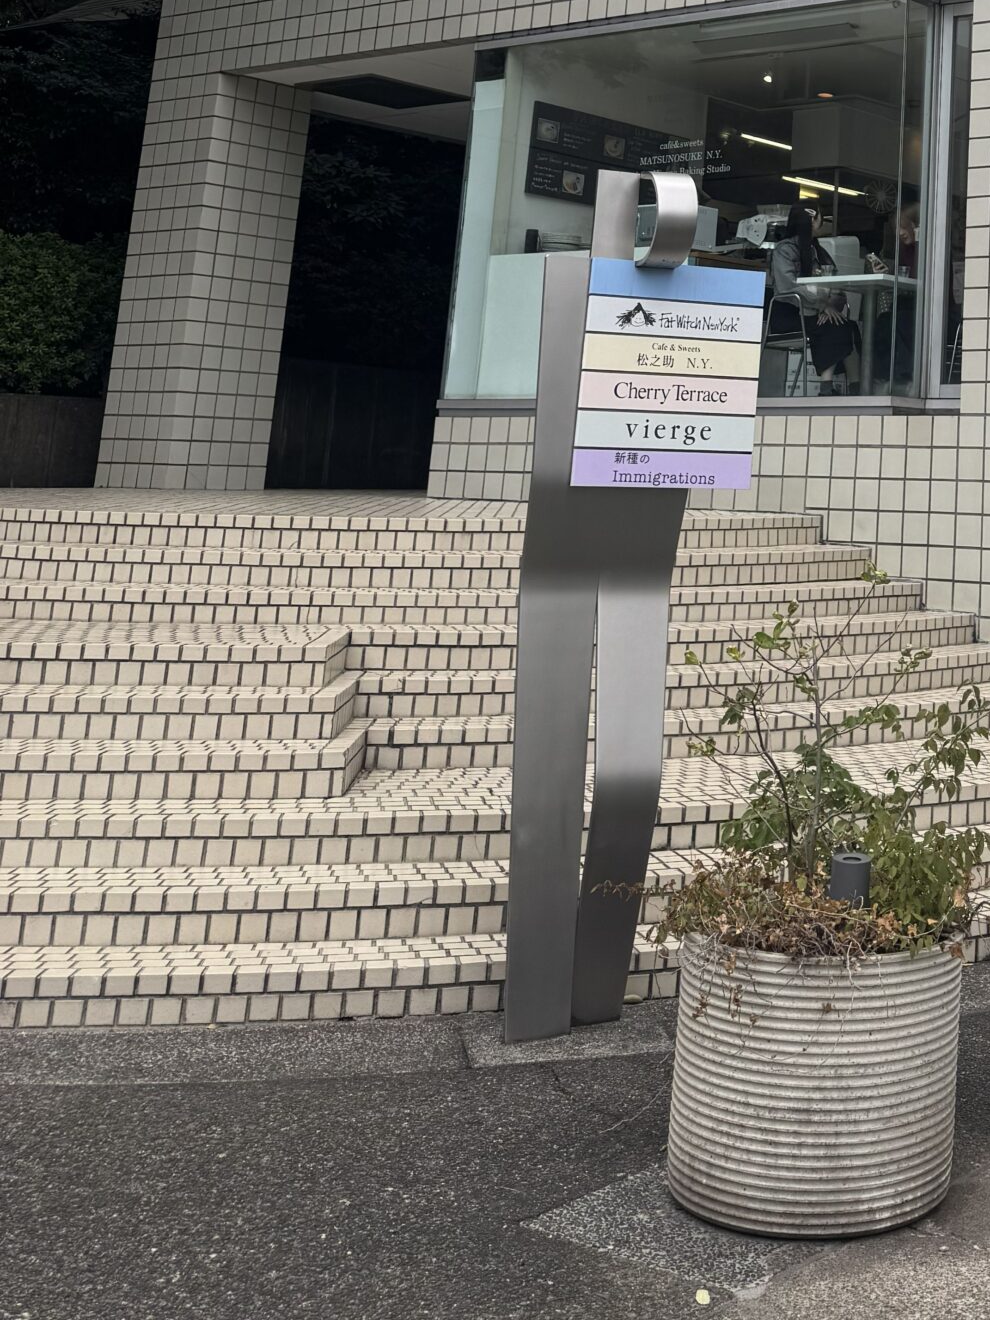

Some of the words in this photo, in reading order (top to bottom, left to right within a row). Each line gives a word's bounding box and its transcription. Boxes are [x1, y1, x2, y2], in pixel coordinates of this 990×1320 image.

[640, 151, 702, 165] MATSUNOSUKE
[706, 150, 723, 160] N.Y.
[706, 164, 731, 174] Studio
[658, 312, 676, 329] Fat
[676, 314, 701, 330] Witch
[652, 342, 668, 351] Cafe
[669, 344, 676, 352] &
[677, 344, 701, 353] Sweets
[637, 353, 675, 368] 松之助
[686, 357, 713, 370] N.Y.
[613, 382, 671, 405] Cherry
[672, 384, 728, 403] Terrace
[625, 418, 712, 446] vierge
[614, 452, 650, 465] 新種の
[612, 470, 715, 486] Immigrations
